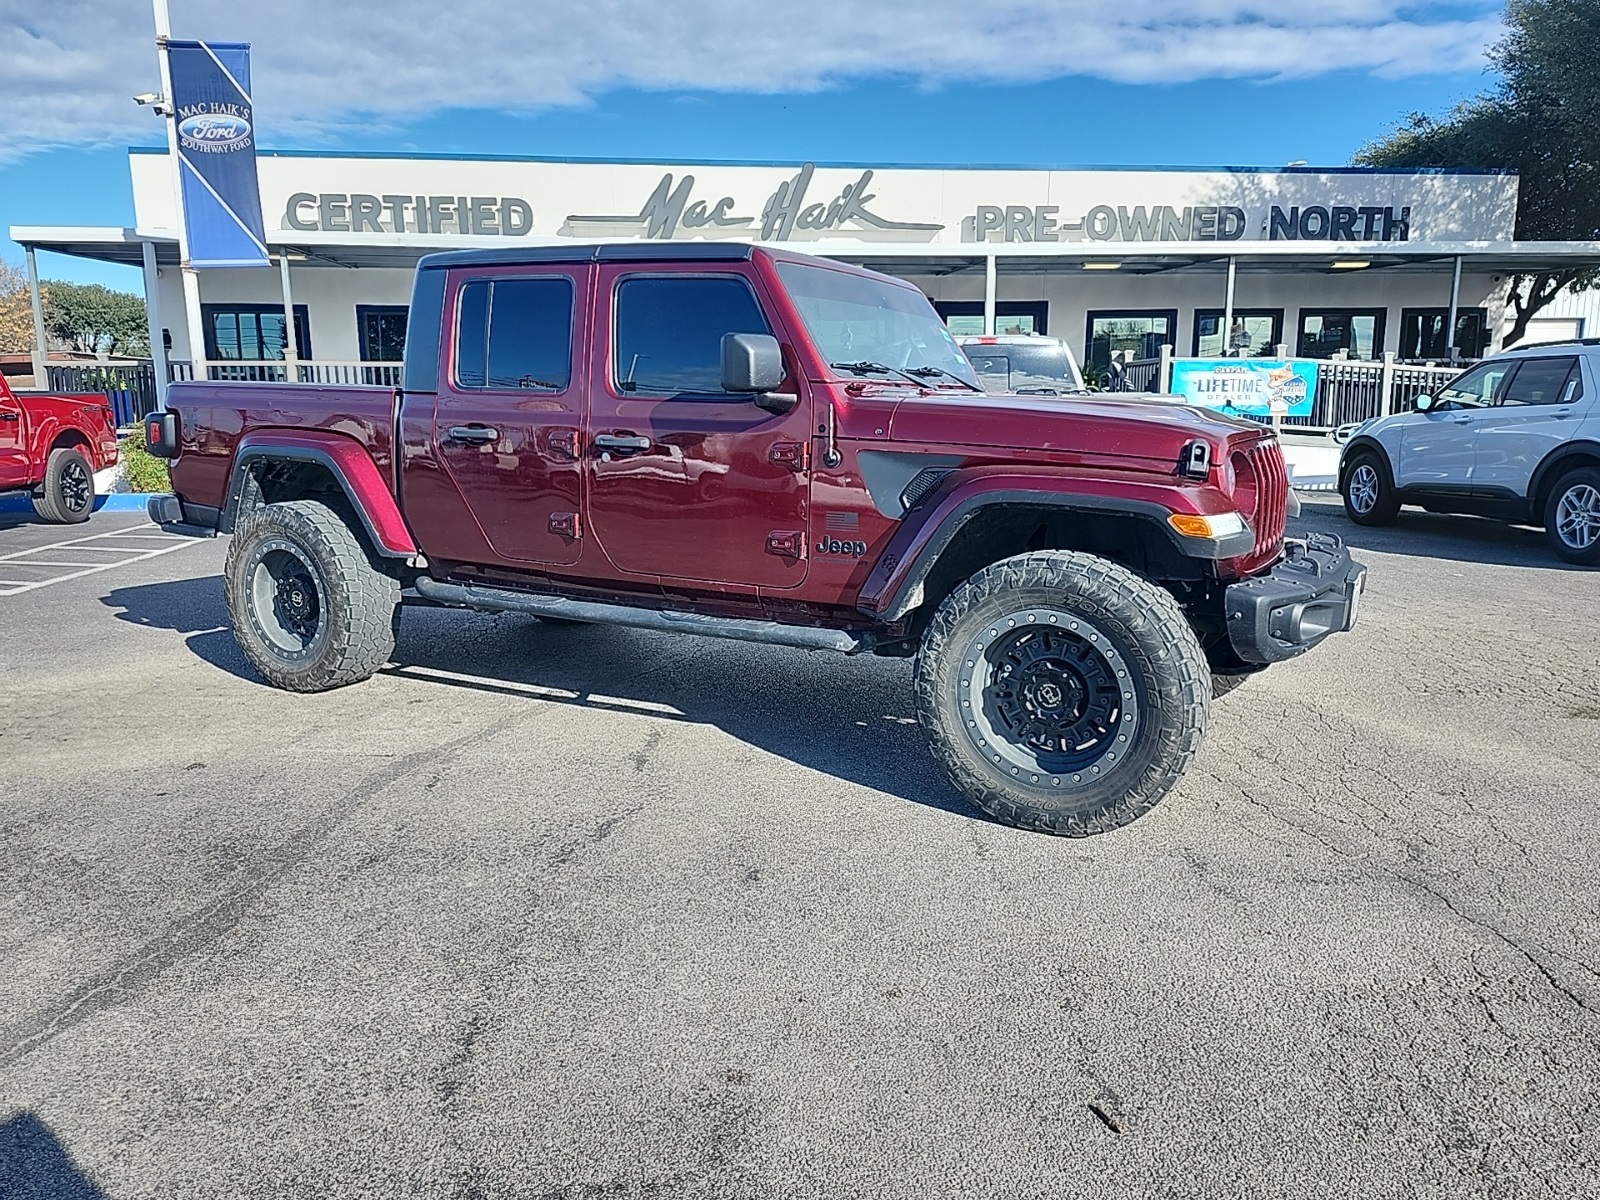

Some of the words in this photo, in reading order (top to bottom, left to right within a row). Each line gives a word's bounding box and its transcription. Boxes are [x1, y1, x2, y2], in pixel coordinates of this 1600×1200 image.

[177, 102, 207, 119] MAC
[210, 102, 251, 119] HAIK'S
[192, 119, 238, 139] Ford
[180, 138, 229, 154] SOUTHWAY
[230, 136, 252, 152] FORD
[566, 173, 755, 239] Mac
[761, 161, 945, 241] Haik
[286, 192, 534, 237] CERTIFIED
[976, 205, 1246, 242] PRE-OWNED
[1268, 205, 1410, 242] NORTH
[1197, 378, 1263, 393] LIFETIME
[815, 535, 867, 558] Jeep
[1063, 593, 1126, 632] TOYO
[999, 787, 1060, 811] OPEN
